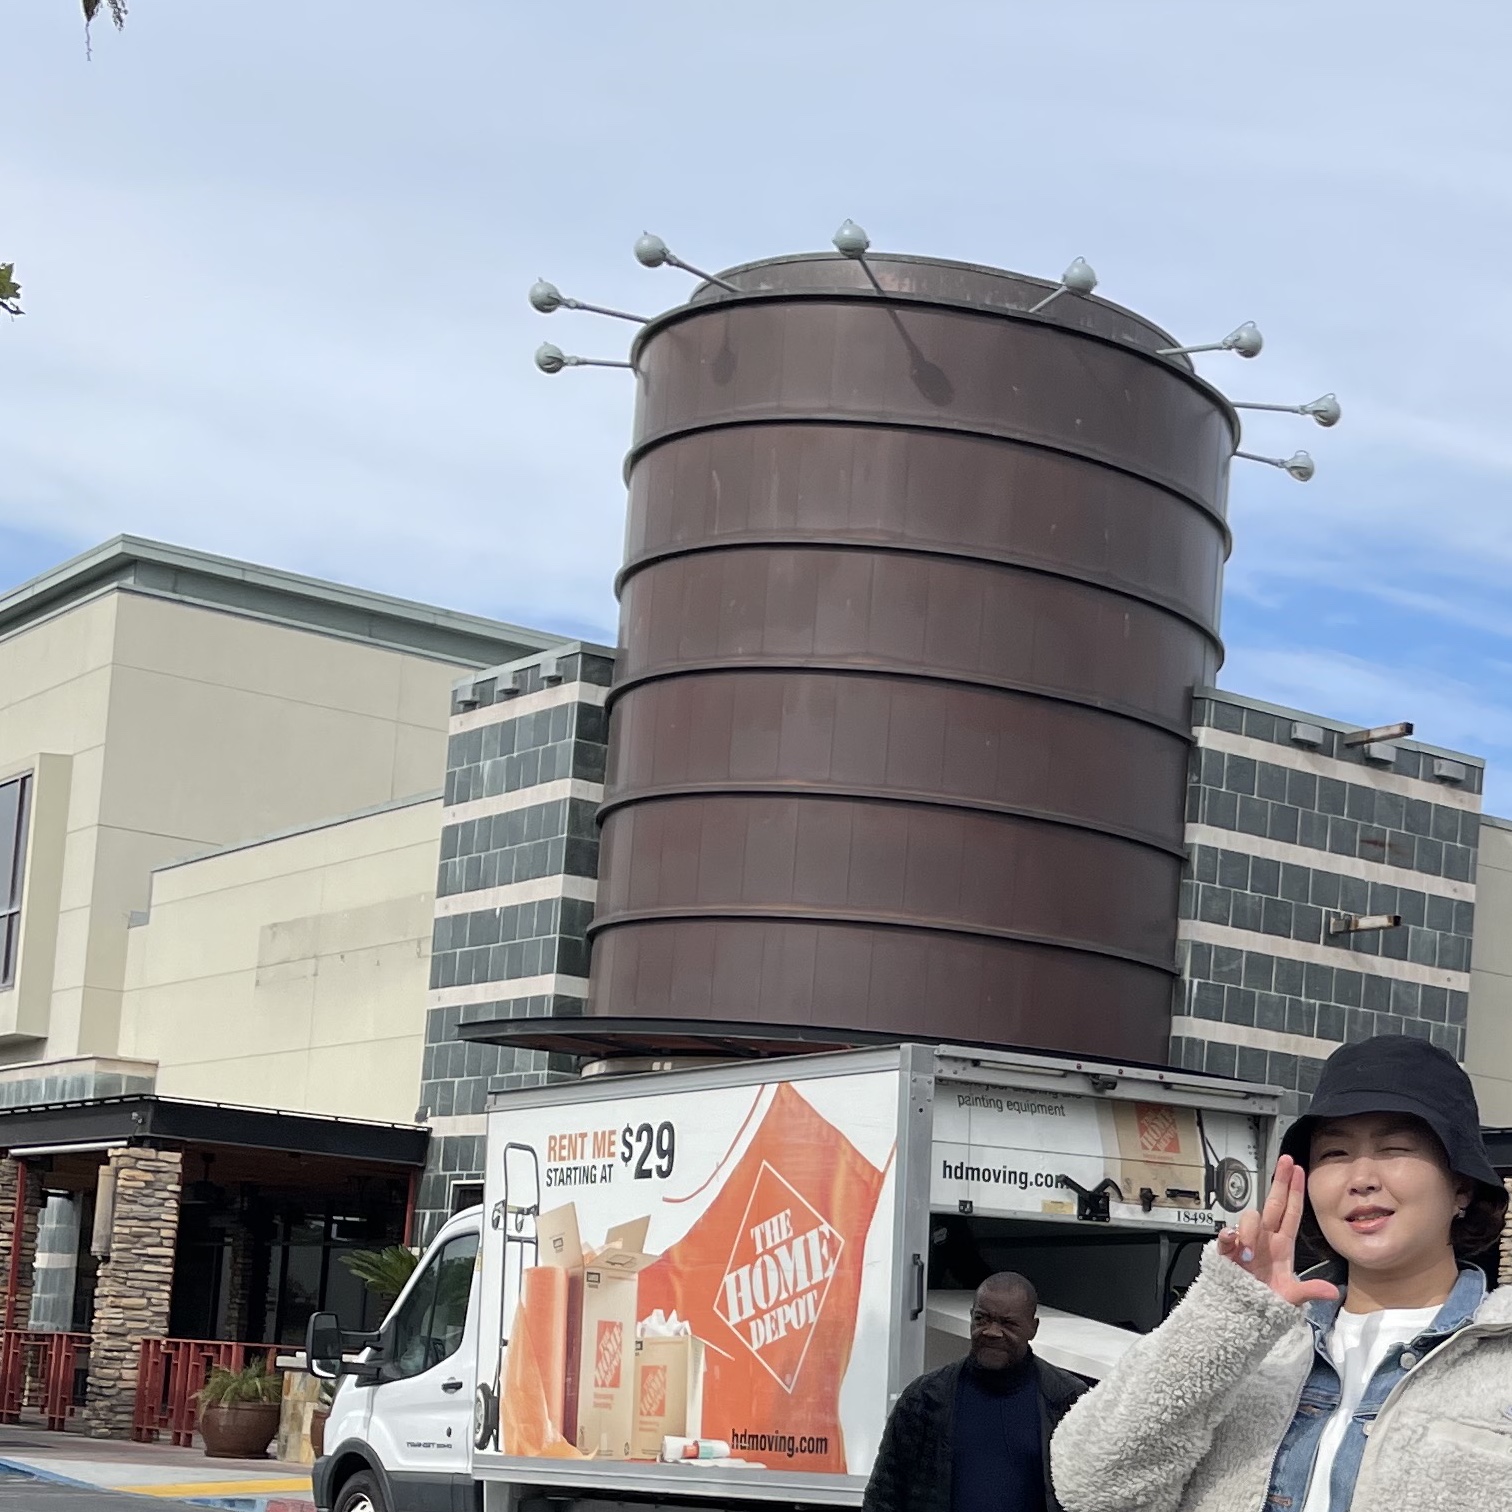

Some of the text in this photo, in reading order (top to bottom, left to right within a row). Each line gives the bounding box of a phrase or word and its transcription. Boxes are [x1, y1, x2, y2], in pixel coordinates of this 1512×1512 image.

[957, 1094, 1066, 1117] painting equipment
[547, 1129, 617, 1163] RENT ME
[620, 1120, 675, 1180] $29
[545, 1163, 614, 1188] STARTING AT
[750, 1208, 794, 1255] THE
[1176, 1210, 1214, 1224] 18498
[723, 1223, 836, 1326] HOME
[749, 1289, 818, 1351] DEPOT
[731, 1428, 829, 1458] hdmoving.com
